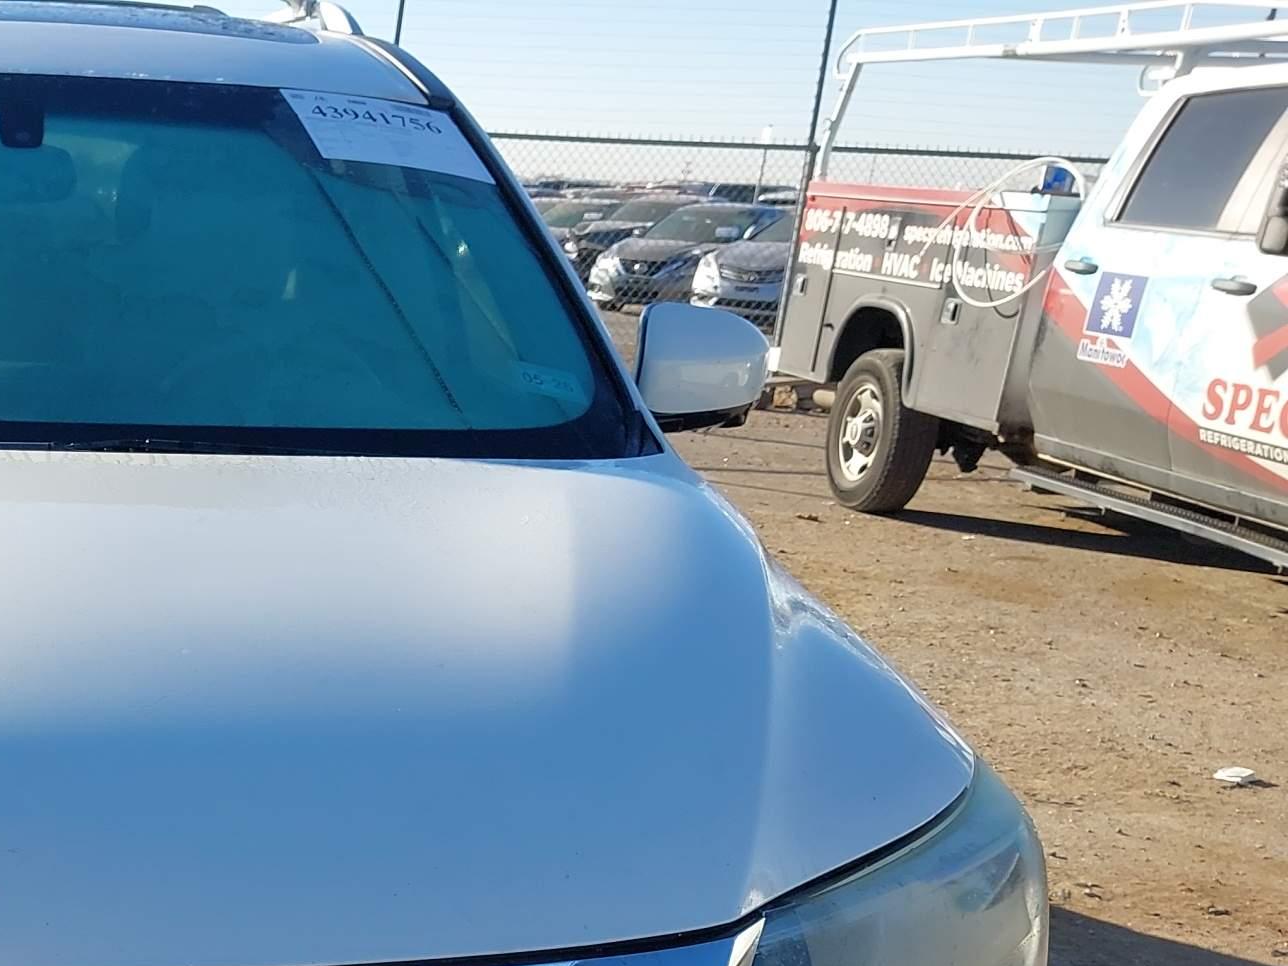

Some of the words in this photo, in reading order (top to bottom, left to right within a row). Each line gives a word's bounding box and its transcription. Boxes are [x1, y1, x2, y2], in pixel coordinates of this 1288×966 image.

[311, 104, 443, 135] 43941756
[805, 208, 890, 239] 806-77-4898
[798, 241, 873, 272] Refrigration
[881, 251, 921, 279] HVAC
[929, 257, 952, 283] Ice
